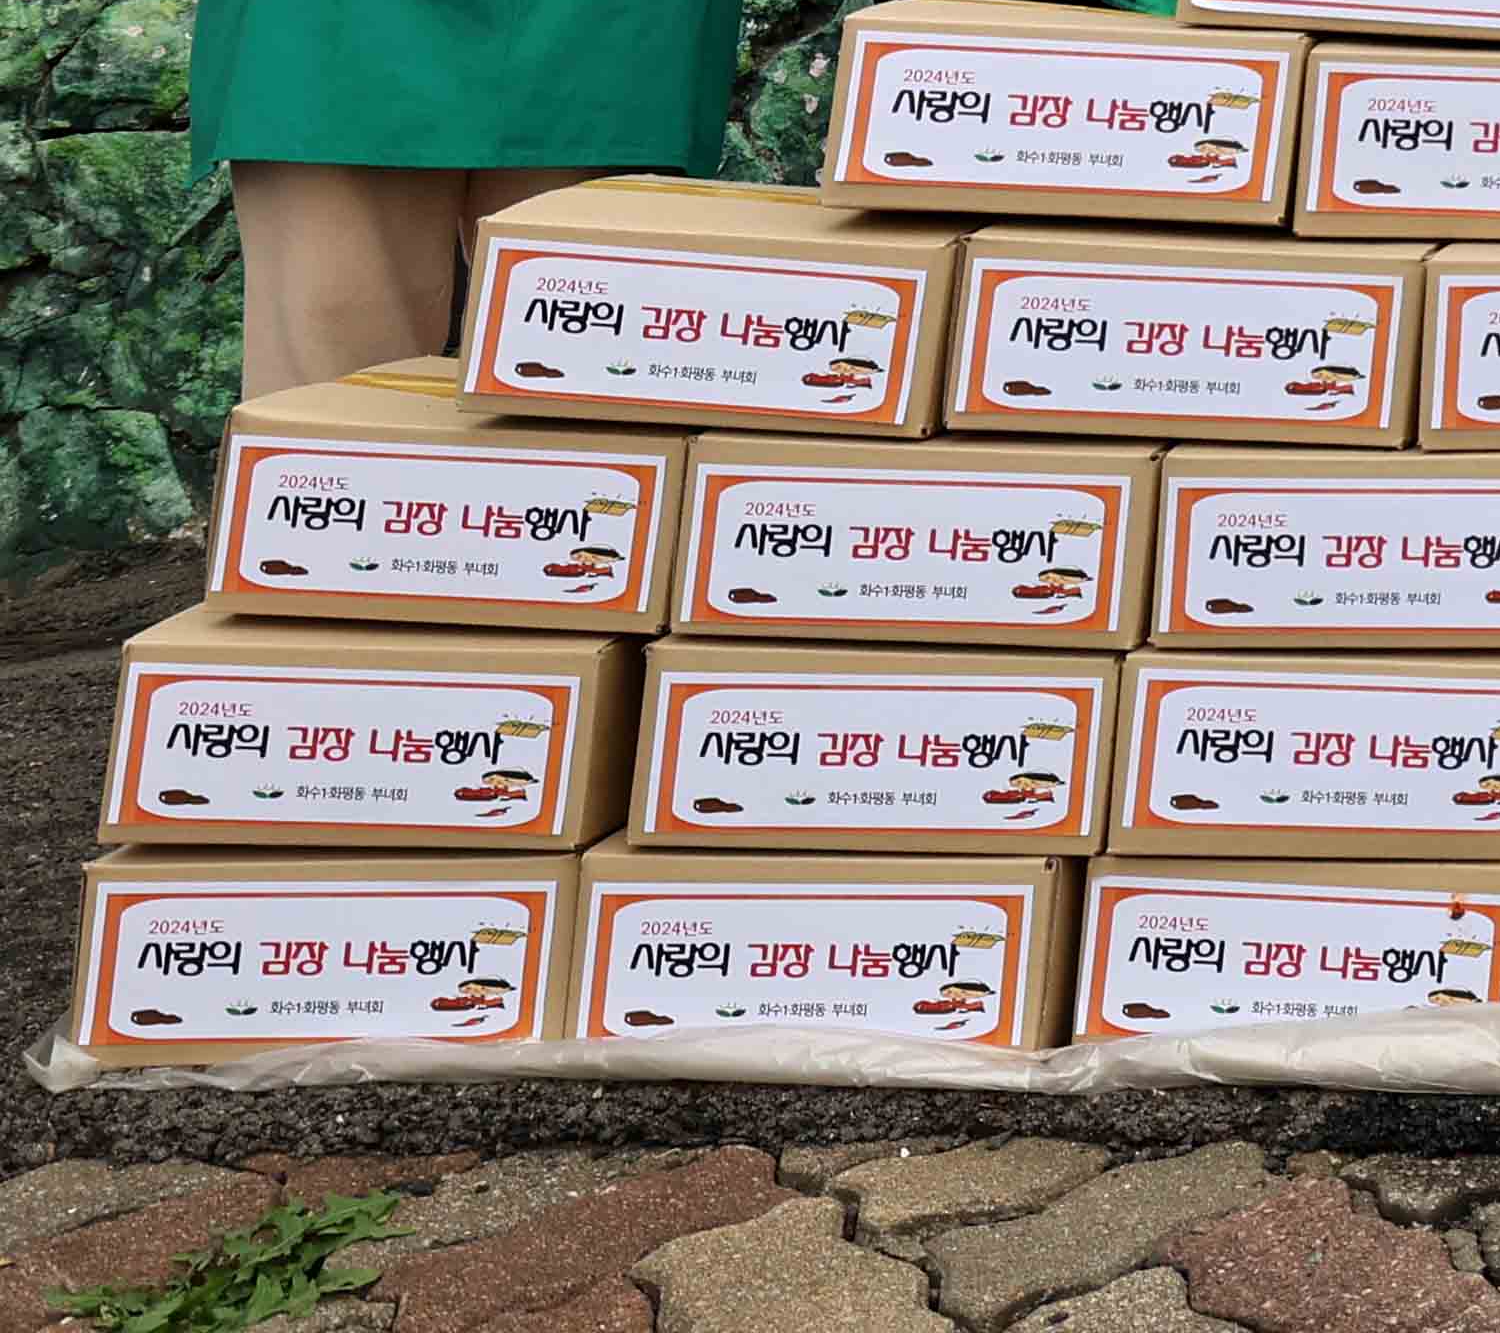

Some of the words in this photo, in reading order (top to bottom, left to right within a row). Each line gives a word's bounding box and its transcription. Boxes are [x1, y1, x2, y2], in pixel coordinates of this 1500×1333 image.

[902, 66, 978, 86] 2024년도
[890, 87, 991, 124] 사랑의
[1006, 94, 1073, 128] 김장
[535, 275, 612, 297] 2024년도
[522, 296, 625, 336] 사랑의
[639, 306, 707, 343] 김장
[743, 500, 819, 519] 2024년도
[733, 522, 833, 557] 사랑의
[849, 526, 914, 560] 김장
[147, 917, 228, 936] 2024년도
[136, 940, 242, 976] 사랑의
[259, 941, 328, 976] 김장
